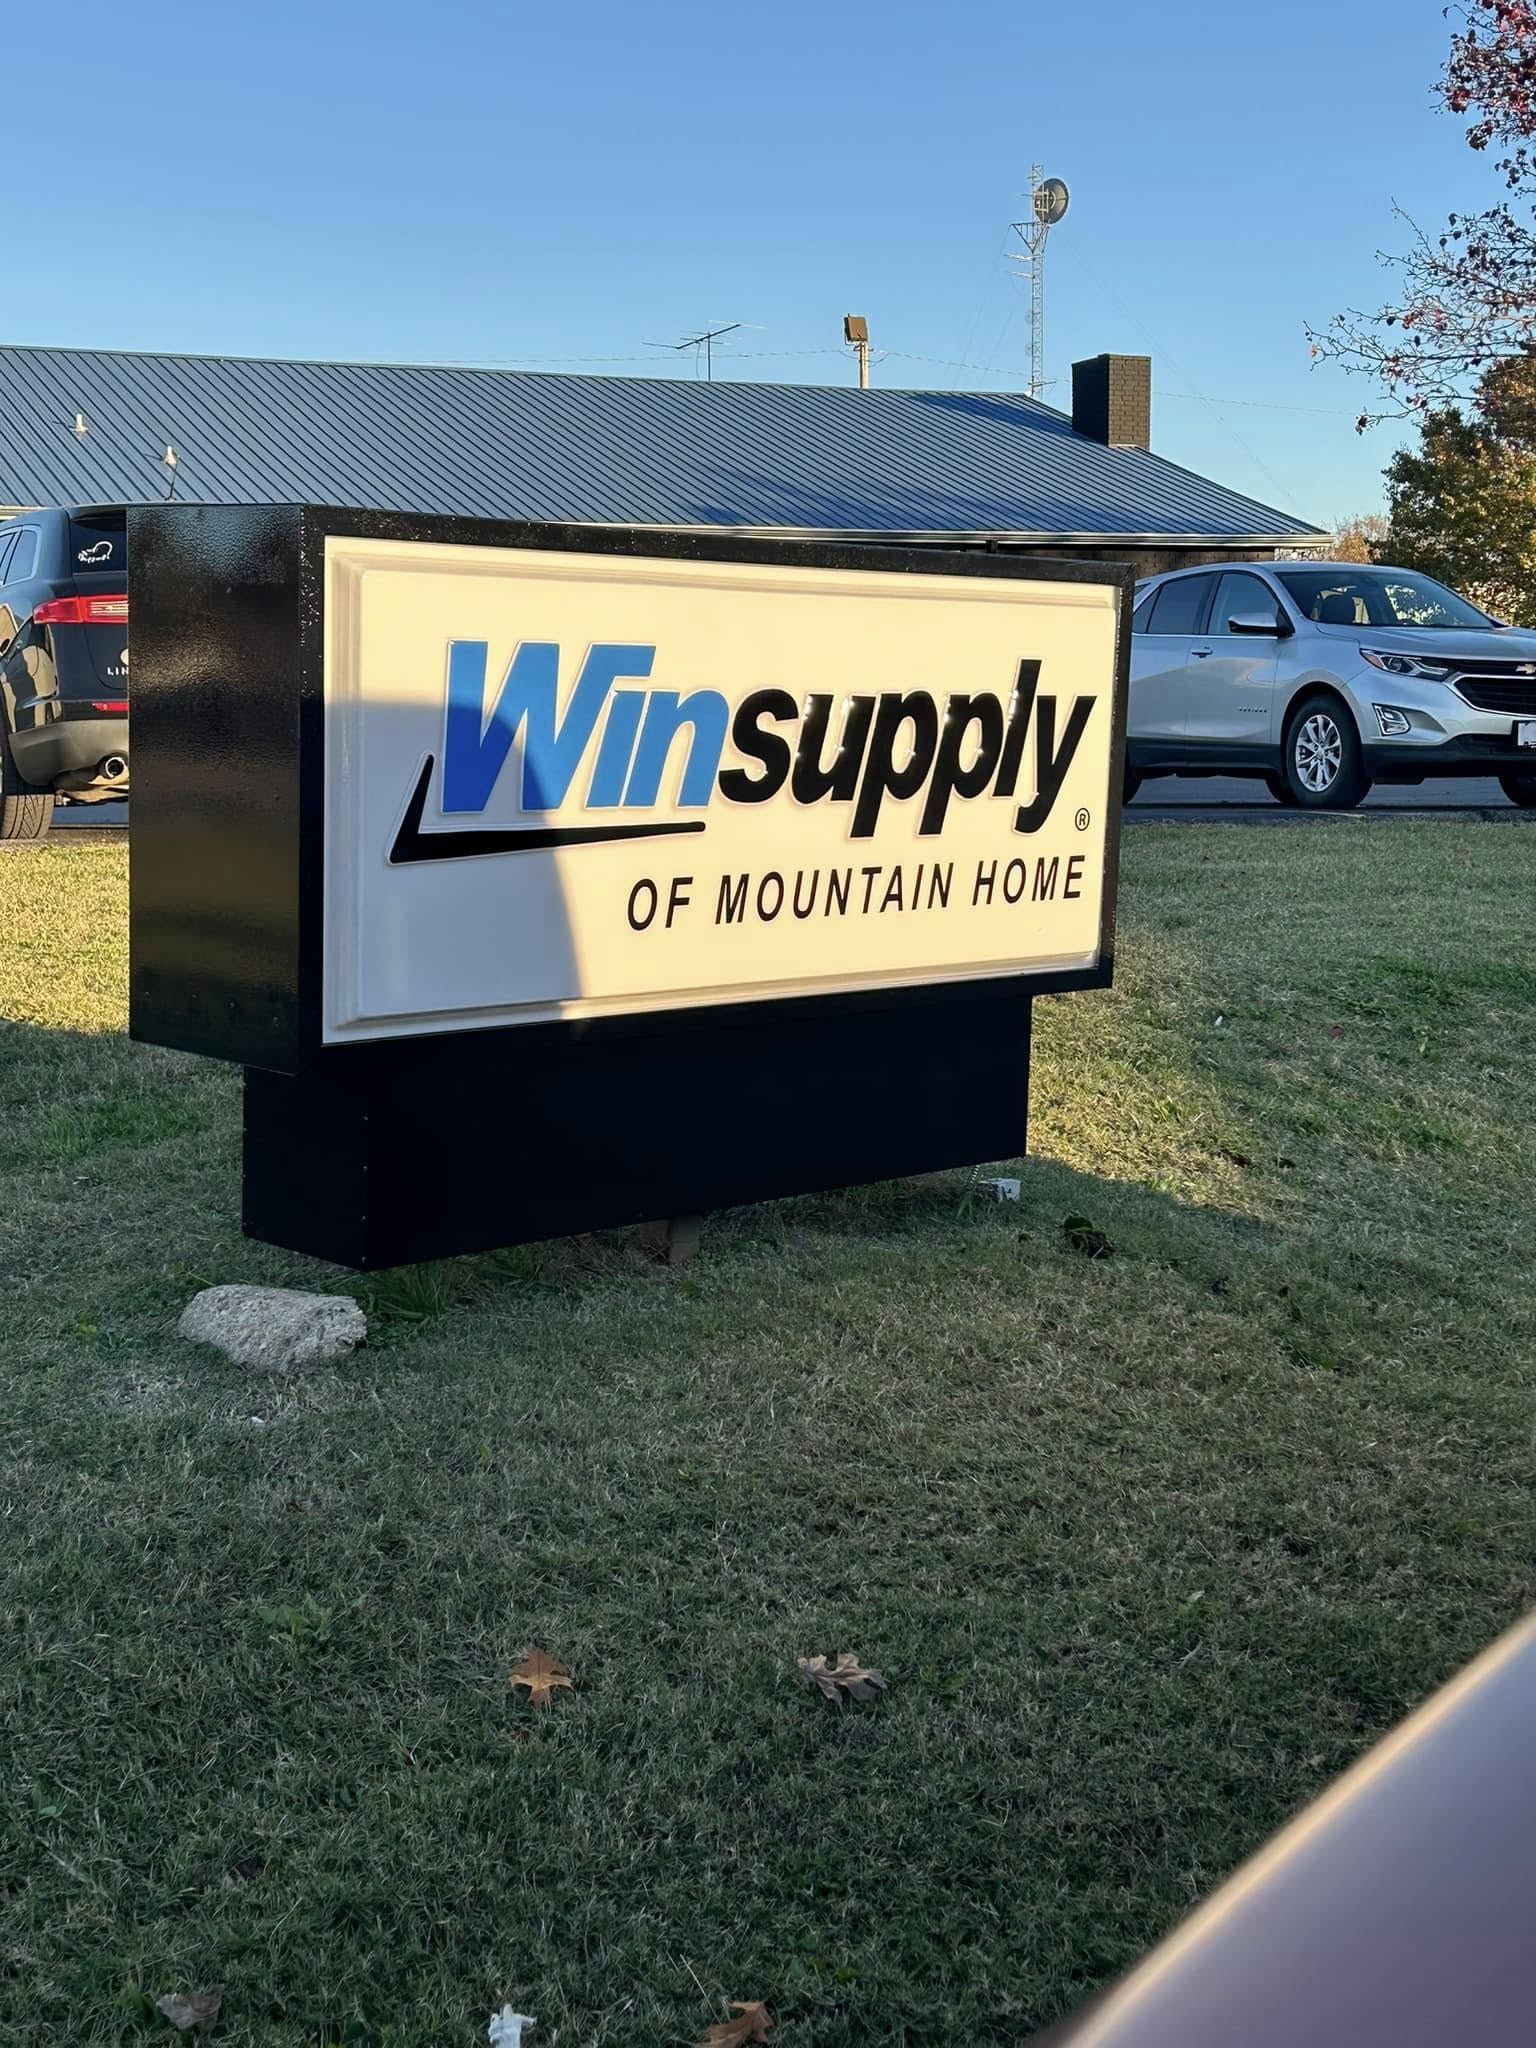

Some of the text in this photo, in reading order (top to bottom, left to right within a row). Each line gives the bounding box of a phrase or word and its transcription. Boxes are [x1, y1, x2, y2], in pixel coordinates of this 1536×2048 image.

[441, 640, 1097, 837] Winsupply
[627, 854, 1086, 932] OF MOUNTAIN HOME
